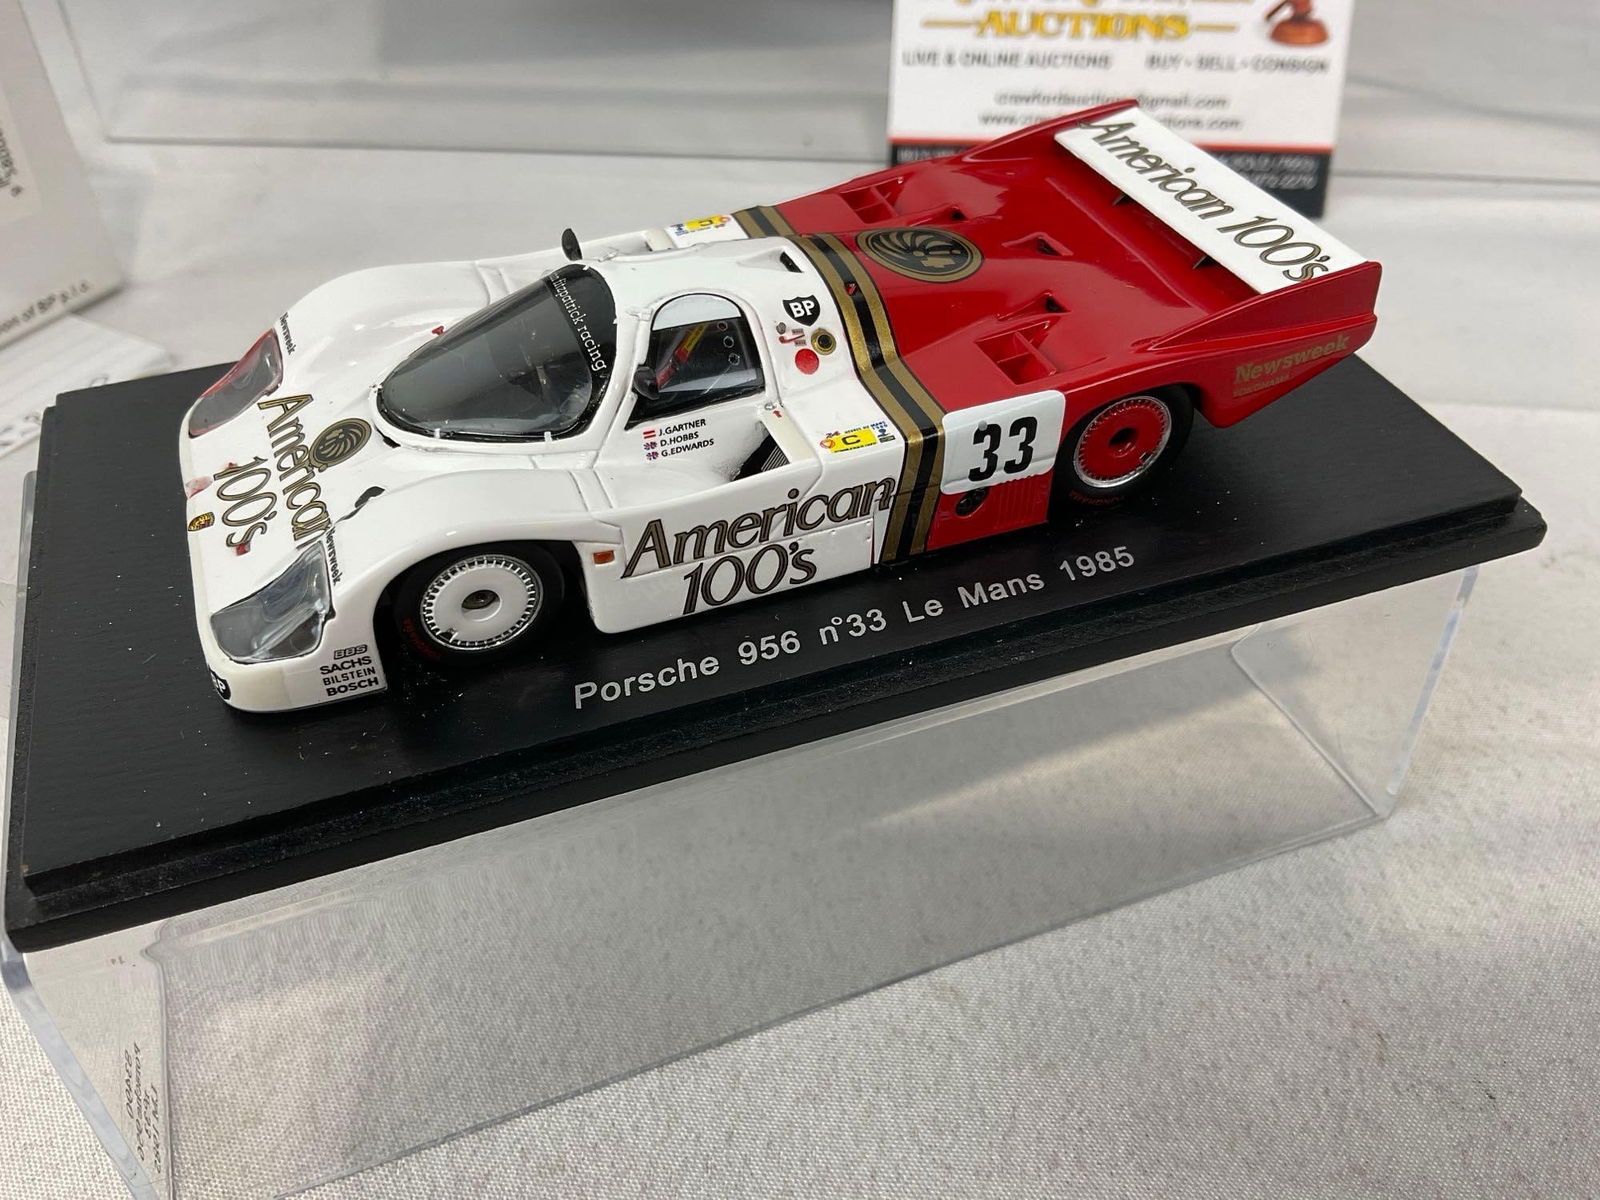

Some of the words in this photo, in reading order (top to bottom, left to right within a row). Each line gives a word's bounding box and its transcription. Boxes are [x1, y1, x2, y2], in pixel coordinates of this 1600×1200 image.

[977, 11, 1189, 40] AUCTIONS
[959, 51, 1021, 69] ONLINE
[1024, 52, 1113, 69] AUCTIONS
[1145, 53, 1182, 71] BUY
[1079, 119, 1234, 220] American
[1217, 214, 1329, 282] 100's
[788, 299, 816, 318] BP
[279, 312, 297, 356] Newsweek
[577, 324, 608, 372] racing
[1233, 334, 1349, 386] Newsweek
[659, 418, 706, 437] J.GARTNER
[660, 431, 699, 447] D.HOBBS
[661, 438, 715, 458] G.EDWARDS
[967, 416, 1038, 482] 33
[258, 393, 333, 549] American
[213, 456, 278, 548] 100's
[620, 476, 897, 579] American
[325, 526, 343, 587] Newsweek
[683, 541, 817, 616] 100's
[574, 656, 720, 710] Porsche
[737, 630, 801, 666] 956
[818, 608, 888, 646] n°33
[902, 599, 944, 624] Le
[957, 572, 1046, 609] Mans
[1059, 545, 1135, 581] 1985
[319, 655, 373, 676] SACHS
[333, 644, 369, 660] BBS
[322, 666, 377, 687] BILSTEIN
[326, 676, 380, 697] BOSCH
